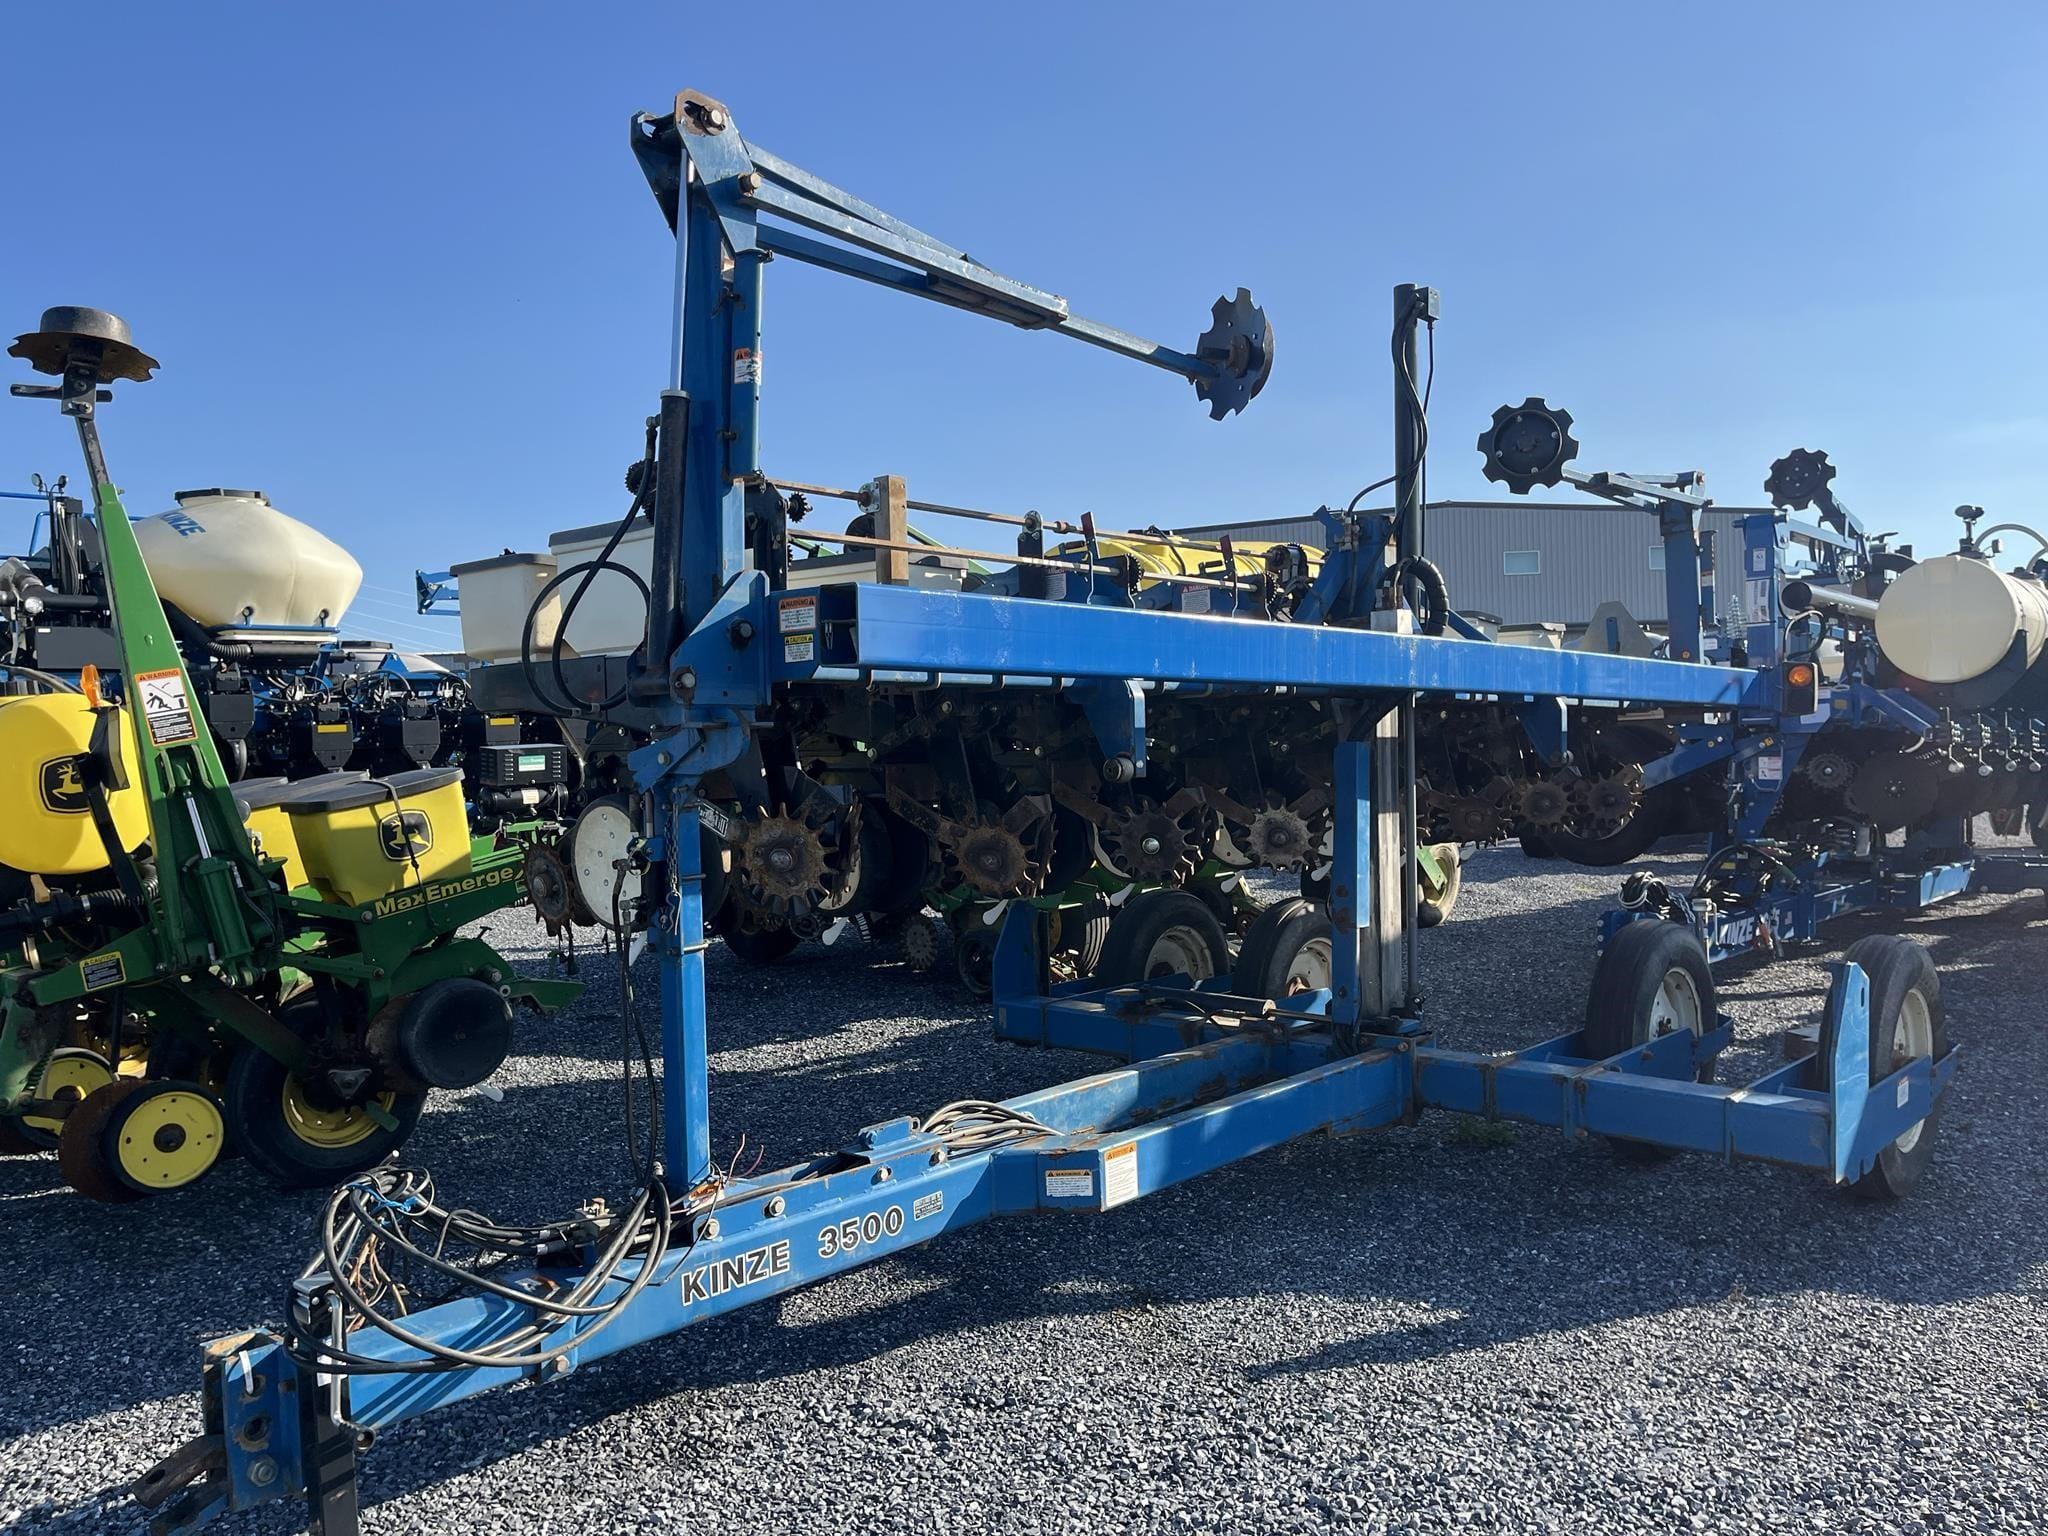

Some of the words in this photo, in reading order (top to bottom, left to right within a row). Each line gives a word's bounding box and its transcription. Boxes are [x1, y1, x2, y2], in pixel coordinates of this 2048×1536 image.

[785, 598, 809, 608] WARNING
[146, 669, 180, 681] WARNING
[374, 867, 514, 917] MaxEmerge
[681, 1239, 790, 1306] KINZE
[818, 1205, 904, 1259] 3500
